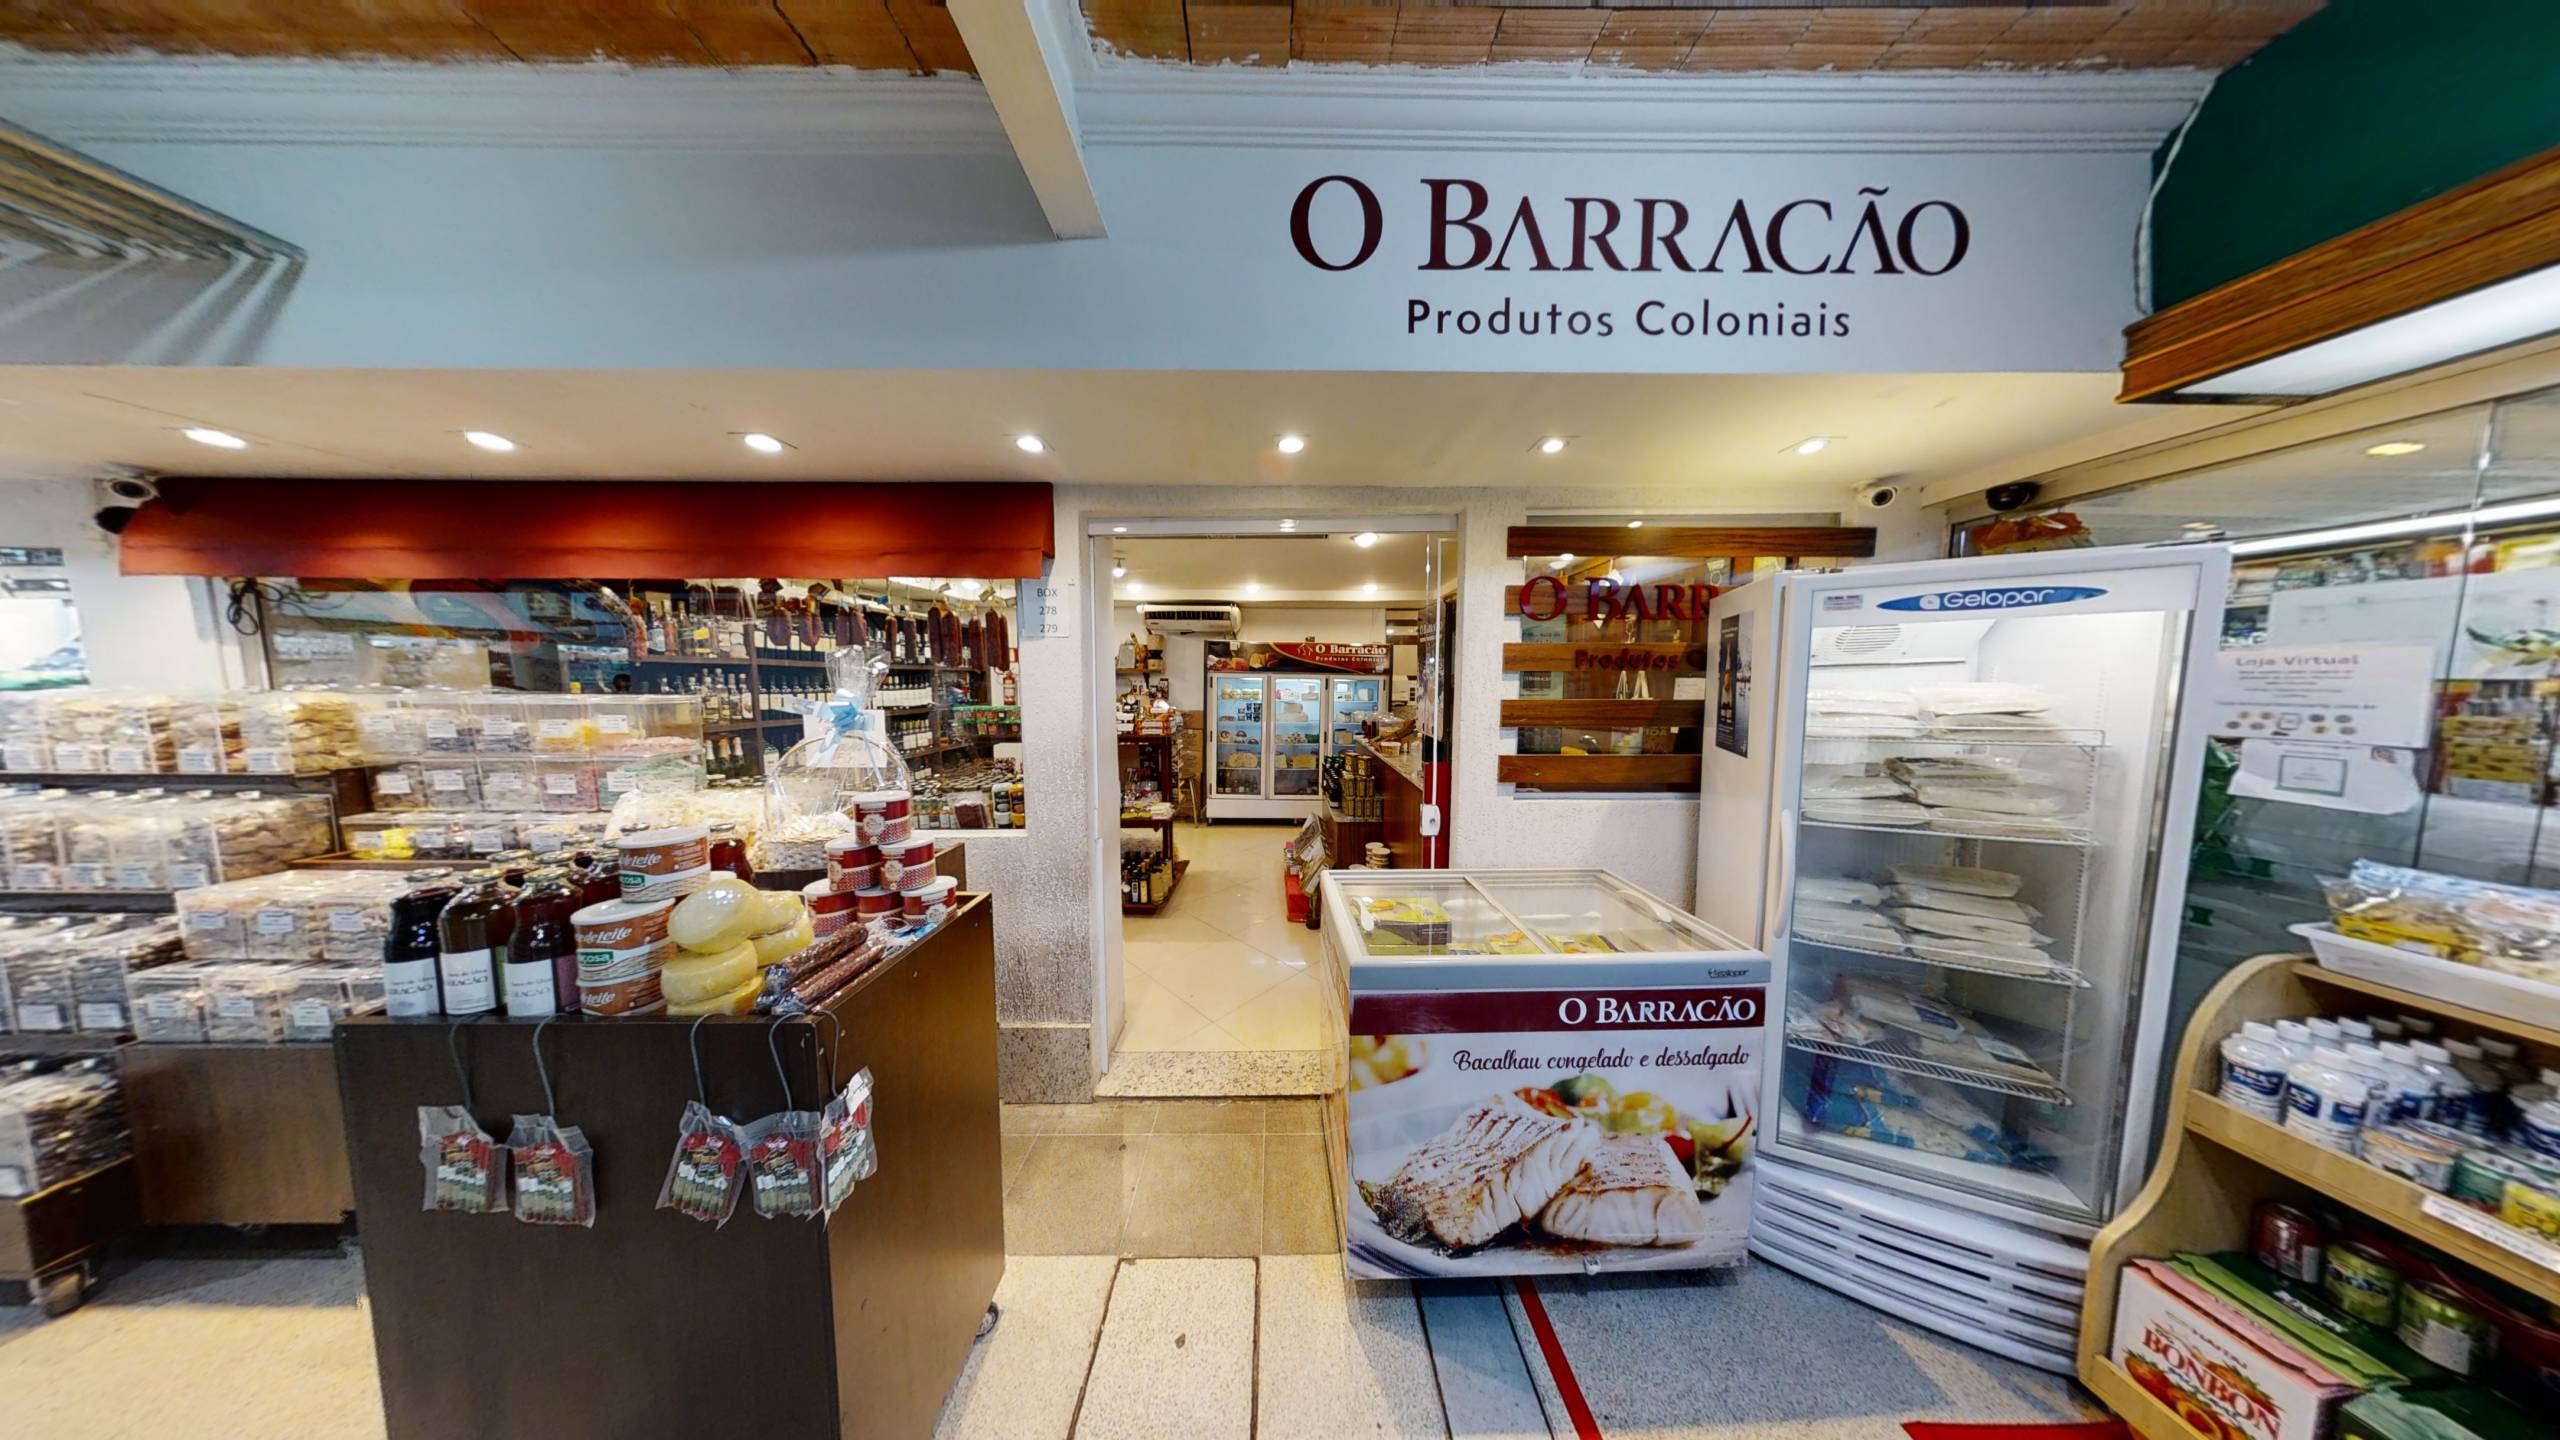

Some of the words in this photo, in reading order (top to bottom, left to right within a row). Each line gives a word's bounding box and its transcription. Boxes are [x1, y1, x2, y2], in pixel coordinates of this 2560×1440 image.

[1290, 175, 1383, 271] O
[1418, 178, 1970, 276] BARRACÃO
[1407, 297, 1614, 337] Produtos
[1635, 297, 1851, 338] Coloniais
[1037, 588, 1058, 597] BOX
[1519, 576, 1567, 621] O
[1584, 576, 1719, 621] BARR
[1943, 590, 2055, 608] Gelopar
[1039, 606, 1057, 615] 278
[1040, 624, 1058, 633] 279
[1315, 644, 1326, 654] O
[1330, 643, 1387, 655] Barracão
[1575, 648, 1679, 670] Produtos
[2235, 656, 2276, 668] Loja
[2282, 654, 2361, 666] Virtual
[1558, 997, 1588, 1025] O
[1595, 995, 1757, 1024] BARRACÃO
[1453, 1049, 1542, 1071] Bacalhau
[1547, 1048, 1634, 1074] congelado
[1639, 1054, 1650, 1067] e
[1655, 1044, 1751, 1070] dessalgado
[2142, 1326, 2282, 1440] BONBON
